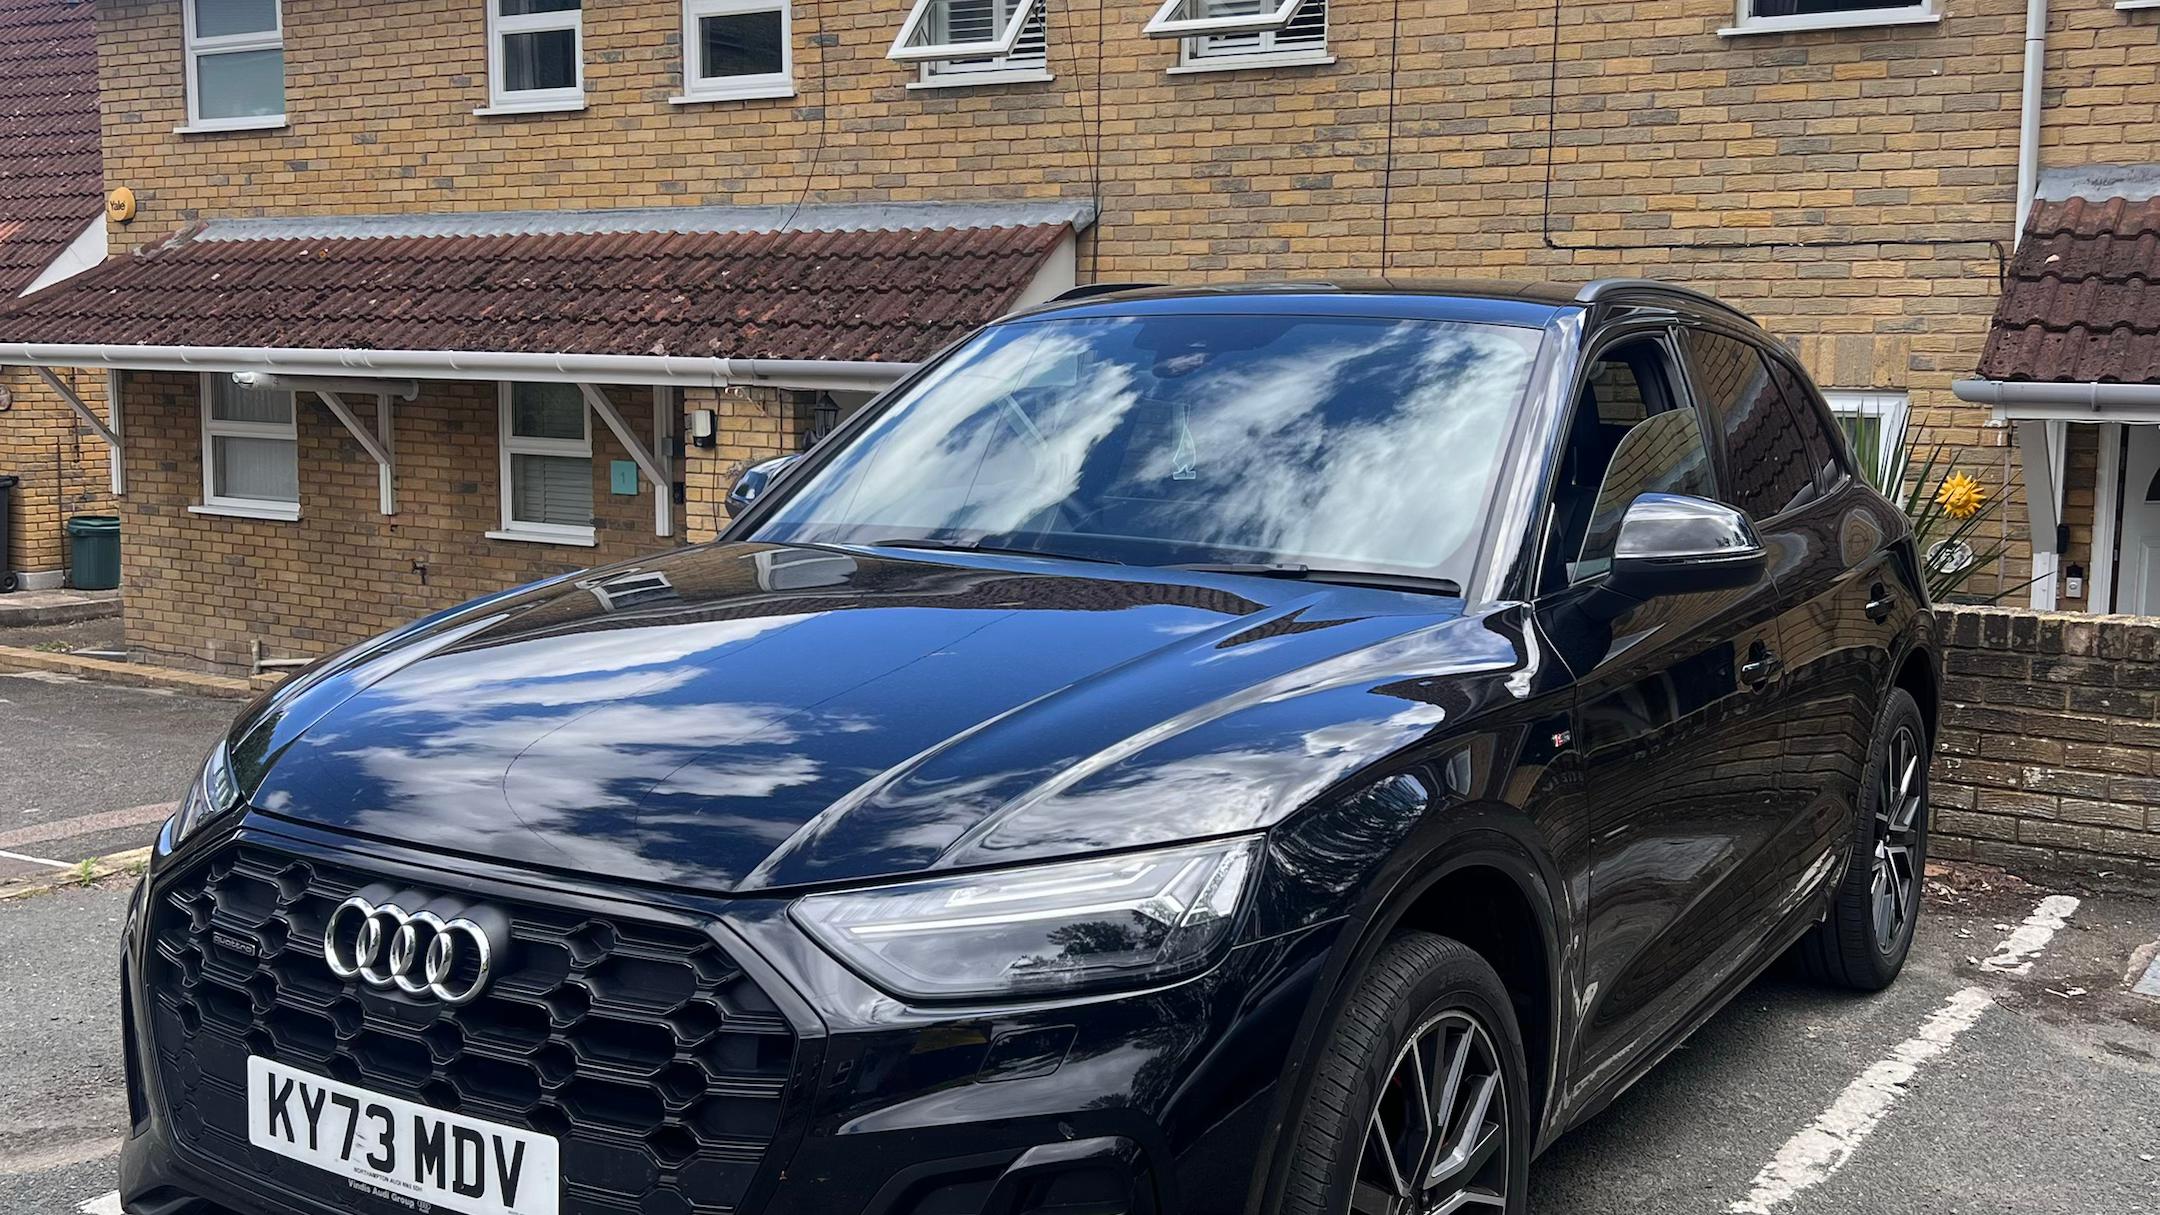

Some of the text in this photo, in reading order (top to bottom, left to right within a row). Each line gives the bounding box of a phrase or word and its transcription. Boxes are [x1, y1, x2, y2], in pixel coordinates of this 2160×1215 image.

[109, 200, 126, 211] Yale
[268, 1072, 526, 1209] KY73 MDV
[348, 1179, 415, 1209] Vindis Audi Group
